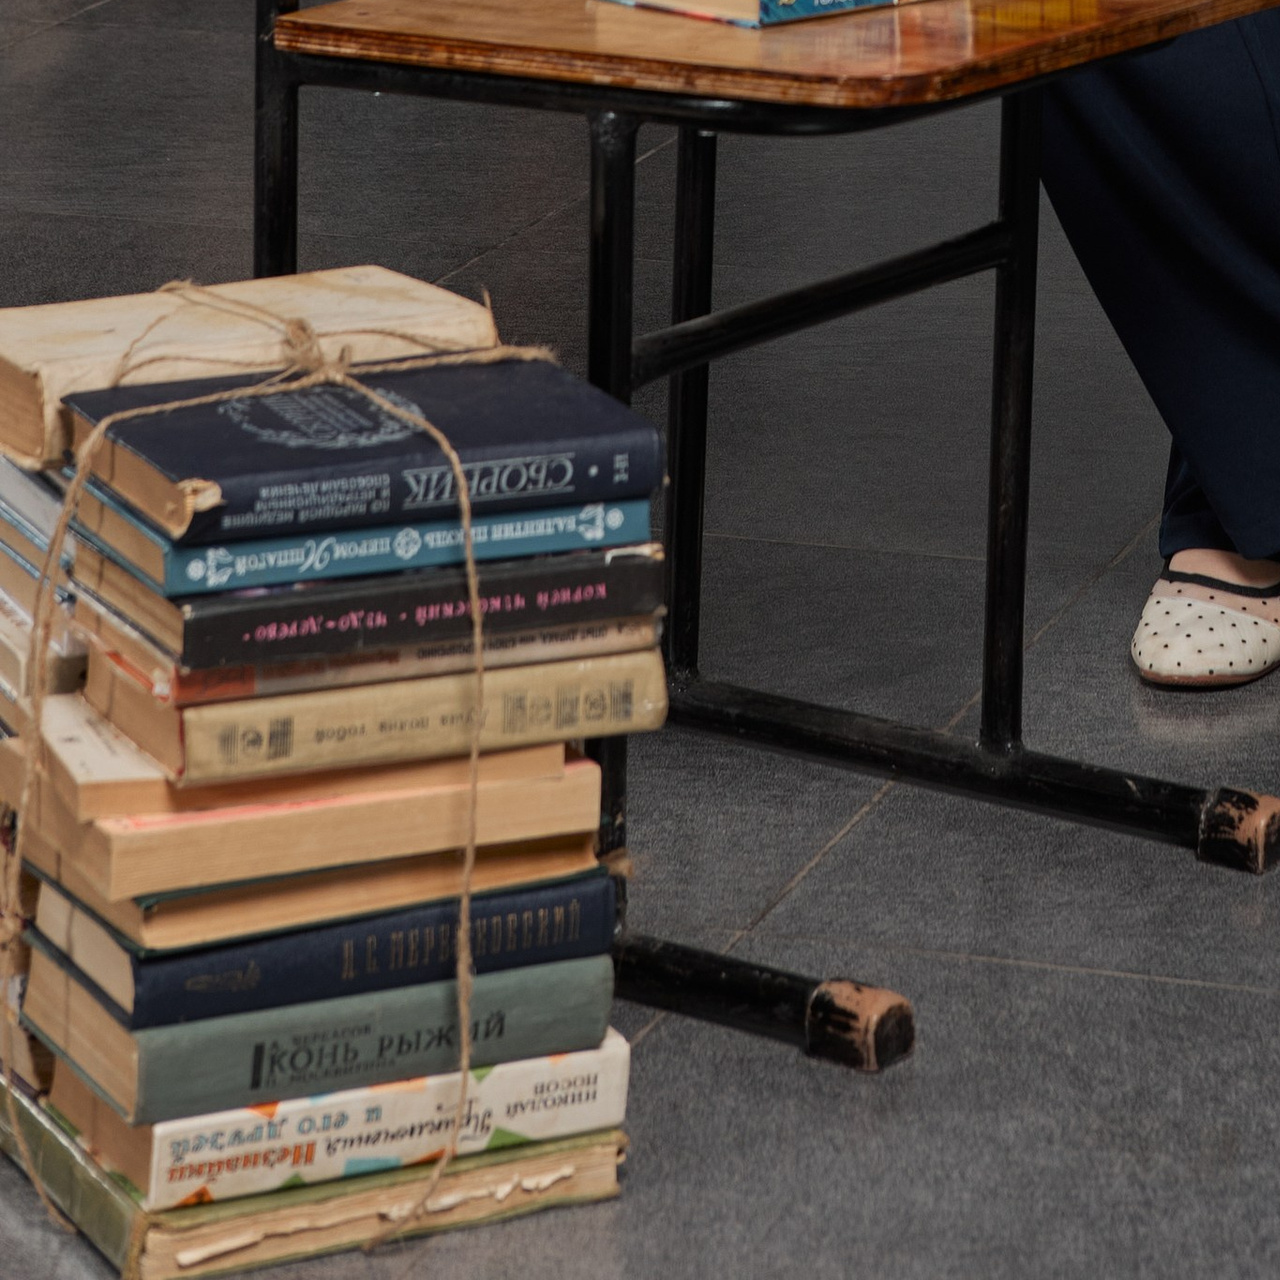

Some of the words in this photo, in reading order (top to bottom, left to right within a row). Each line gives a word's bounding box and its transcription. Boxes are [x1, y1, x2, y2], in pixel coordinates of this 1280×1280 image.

[492, 515, 577, 541] ВАЛЕНТИН
[234, 547, 305, 575] ШПАГОЙ
[333, 536, 392, 560] ПЕРОМ
[268, 1038, 360, 1076] КОНЬ
[533, 1072, 600, 1095] НОСОВ
[365, 1104, 383, 1123] и
[505, 1088, 599, 1120] НИКОЛАЙ
[297, 1111, 349, 1134] его
[171, 1119, 290, 1163] друзей
[167, 1140, 317, 1185] Незнайки
